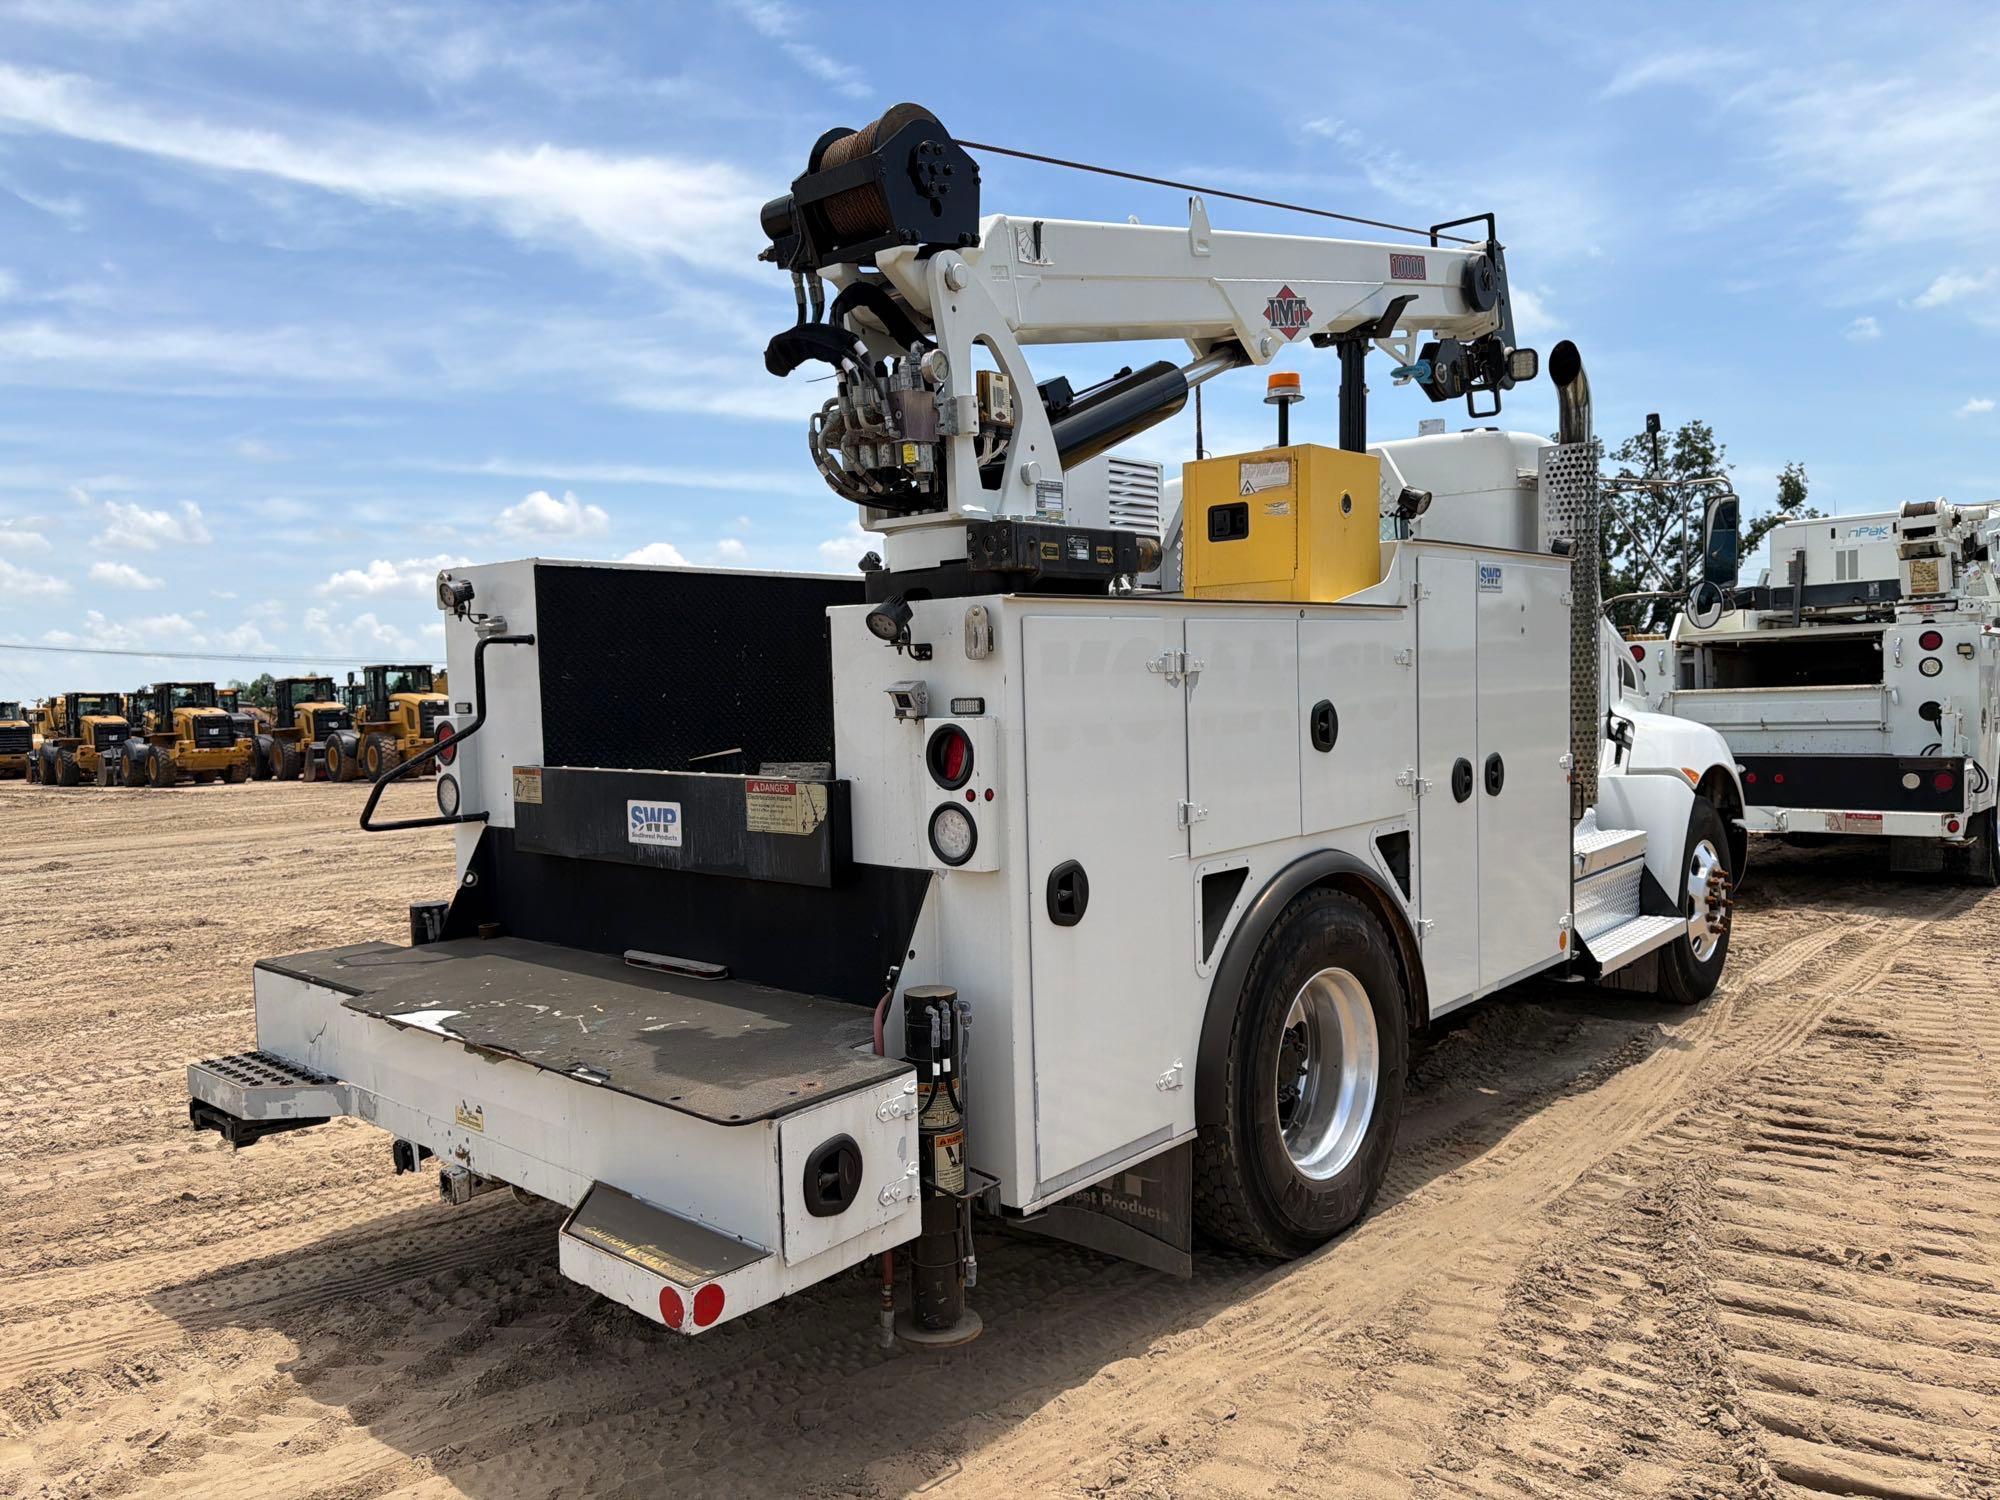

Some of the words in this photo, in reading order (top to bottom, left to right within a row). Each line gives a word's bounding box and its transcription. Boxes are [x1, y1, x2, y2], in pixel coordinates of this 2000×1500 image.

[1392, 255, 1425, 279] 10000
[1267, 297, 1309, 329] IMT
[1481, 566, 1502, 584] SWP
[760, 782, 791, 793] DANGER
[631, 805, 677, 833] SWP
[1102, 1191, 1169, 1222] Products
